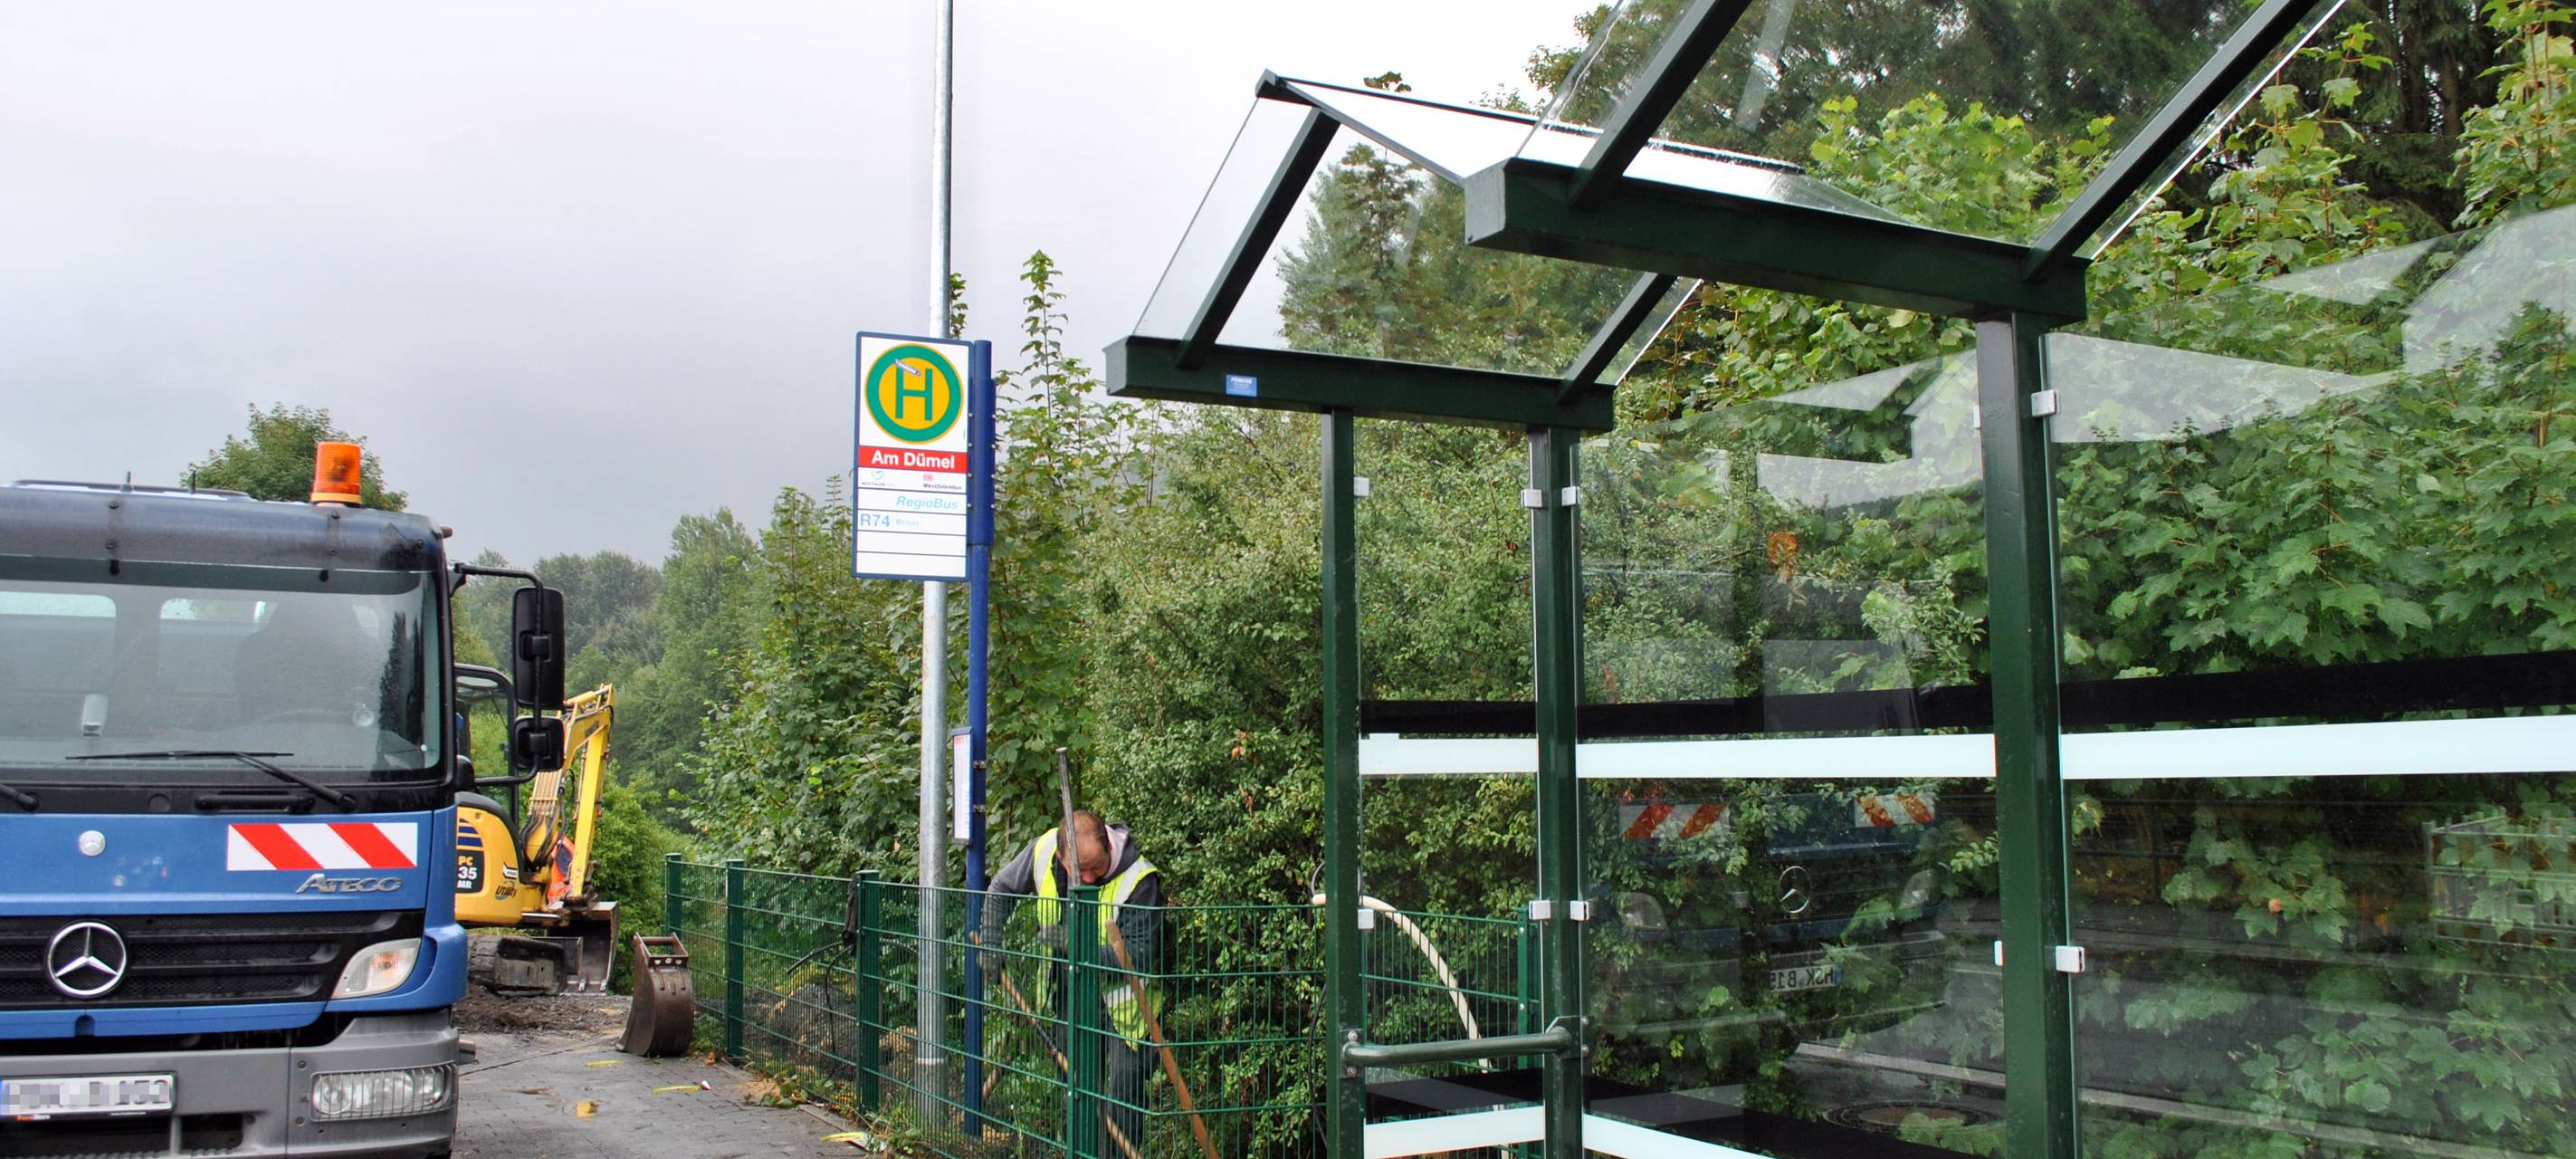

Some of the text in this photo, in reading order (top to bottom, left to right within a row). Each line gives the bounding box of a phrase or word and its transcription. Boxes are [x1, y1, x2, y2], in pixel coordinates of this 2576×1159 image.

[895, 364, 933, 421] H
[872, 450, 955, 469] Am Dümel
[896, 495, 959, 510] RegioBus
[860, 512, 890, 527] R74
[458, 856, 473, 867] PC
[458, 867, 478, 880] 35
